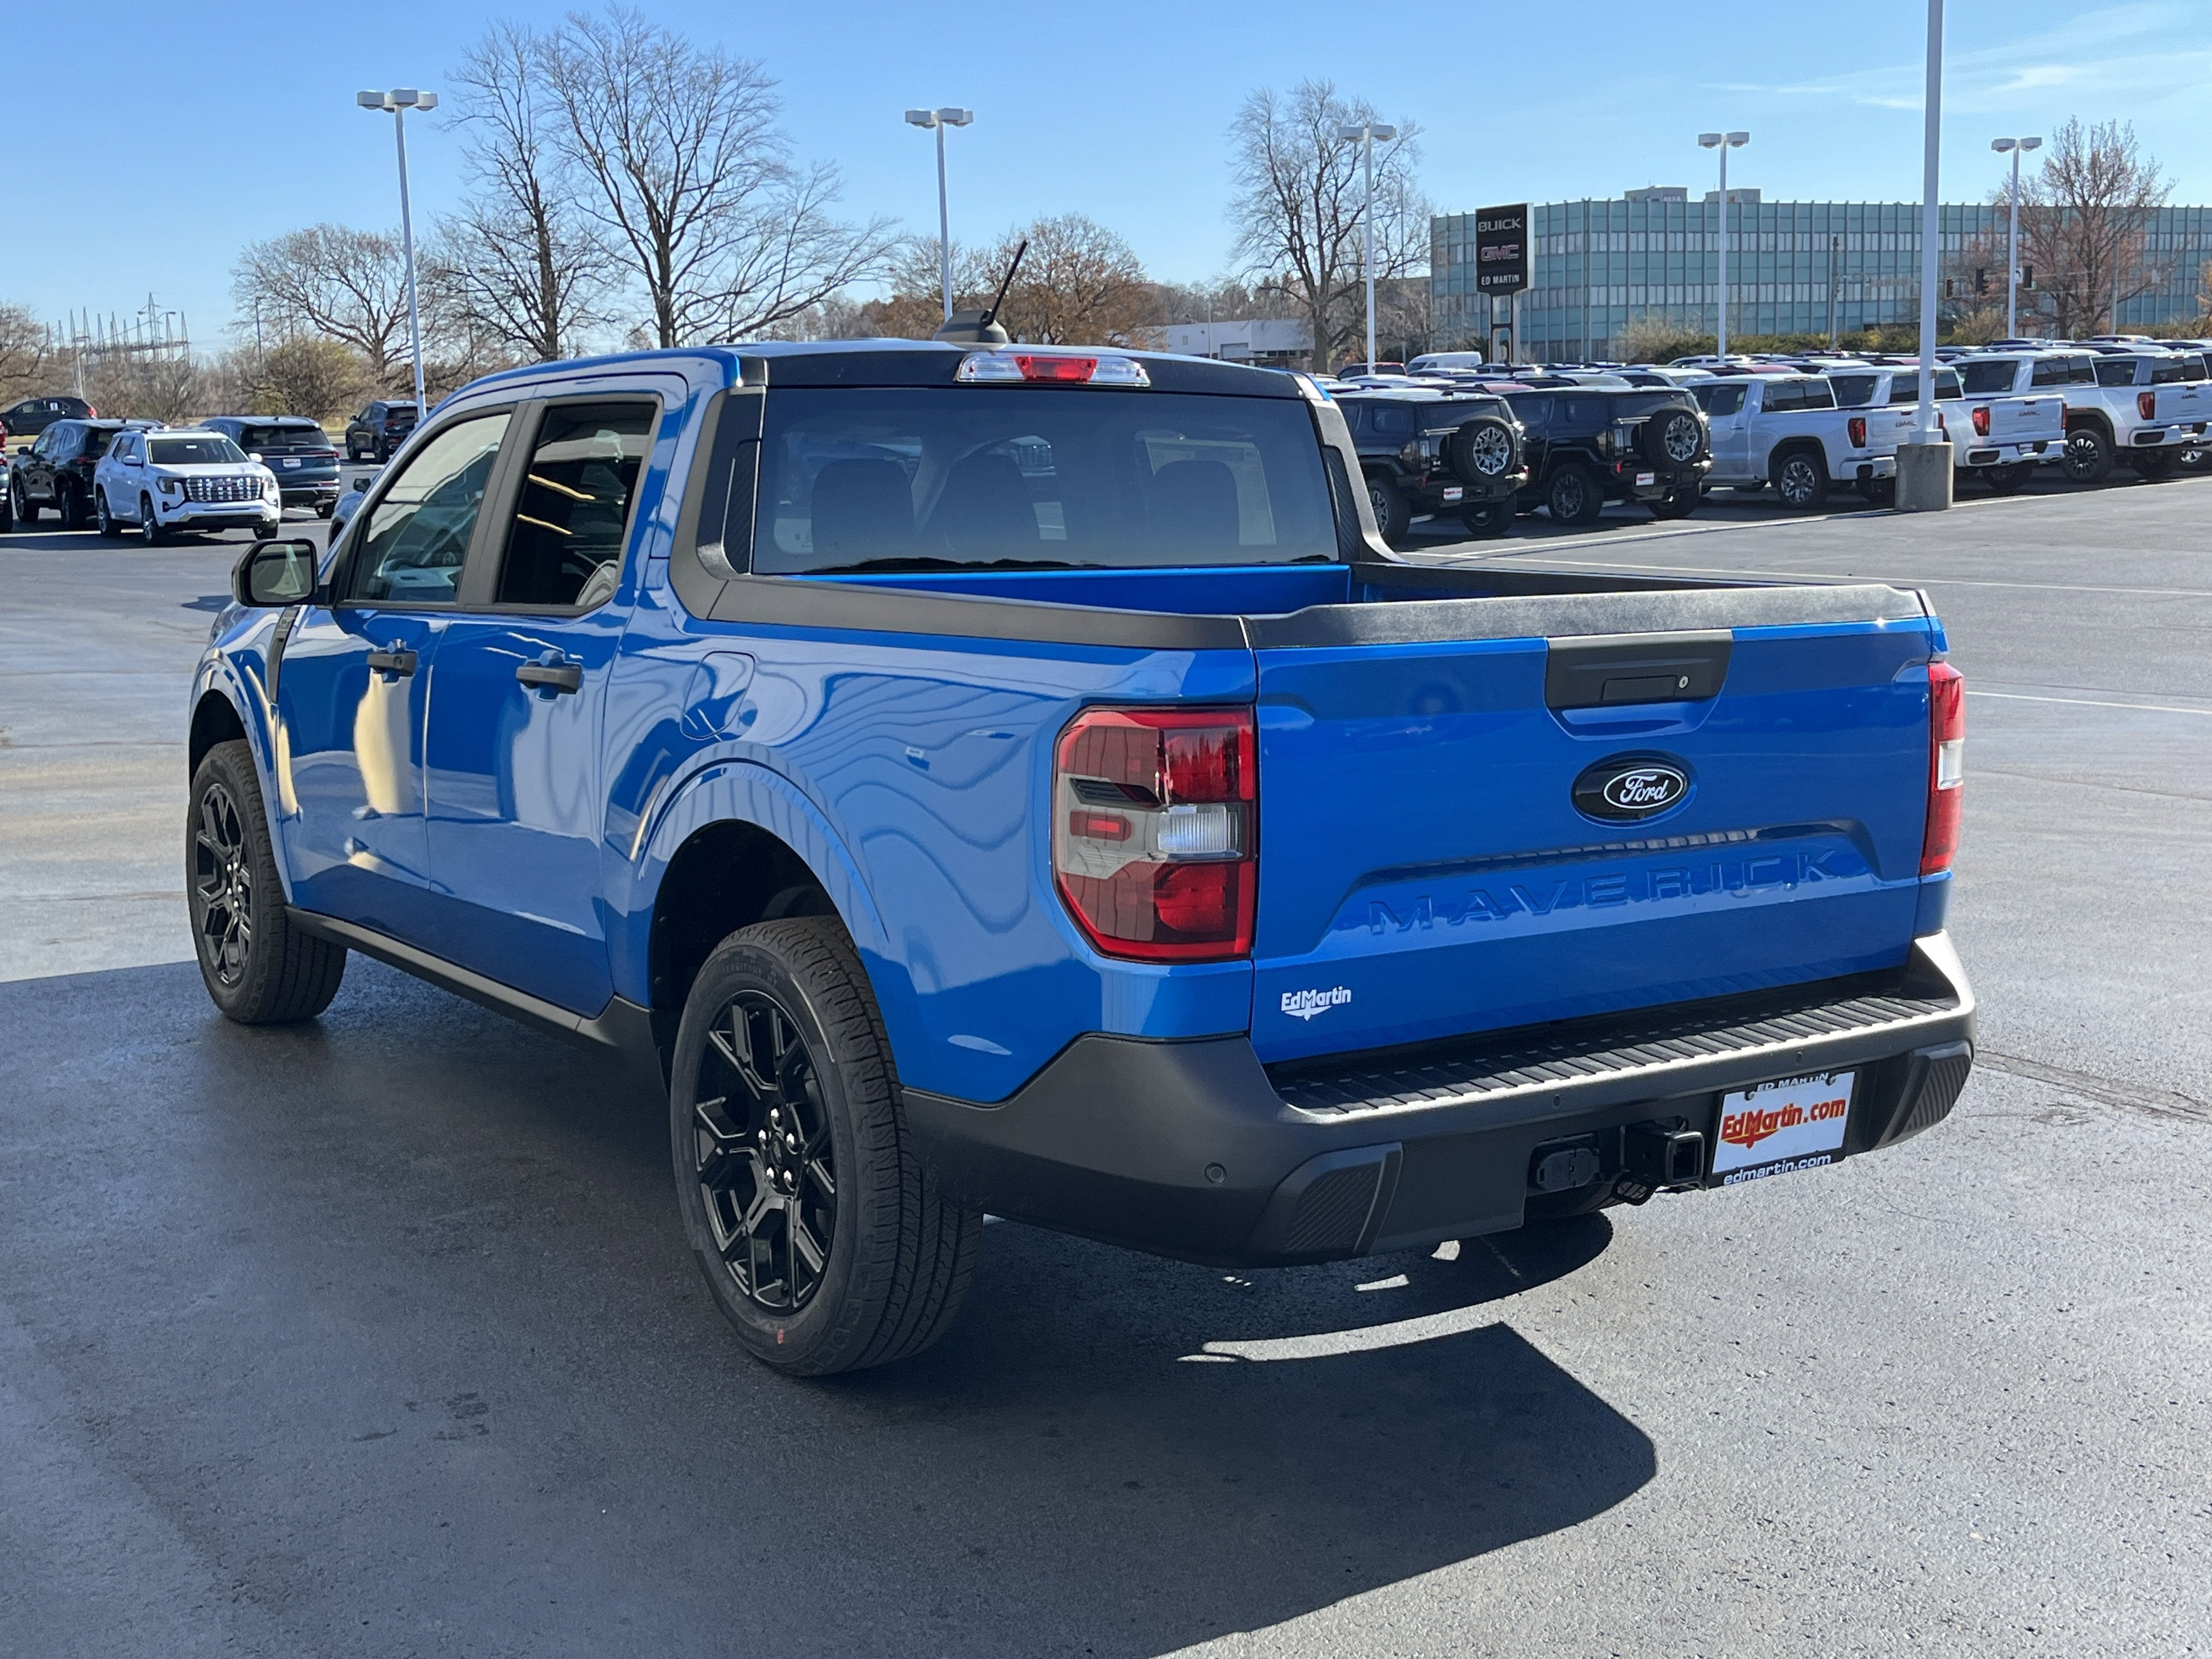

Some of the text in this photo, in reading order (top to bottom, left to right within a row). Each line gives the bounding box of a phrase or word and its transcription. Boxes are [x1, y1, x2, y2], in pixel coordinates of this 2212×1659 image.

[1478, 218, 1521, 232] BUICK
[1481, 244, 1519, 262] GMC
[1493, 274, 1520, 284] MARTIN
[1620, 775, 1669, 803] Ford
[1369, 849, 1838, 935] MAVERICK
[1281, 986, 1352, 1011] EdMartin
[1720, 1099, 1847, 1141] EdMartin.com
[1723, 1154, 1832, 1186] edmartin.com
